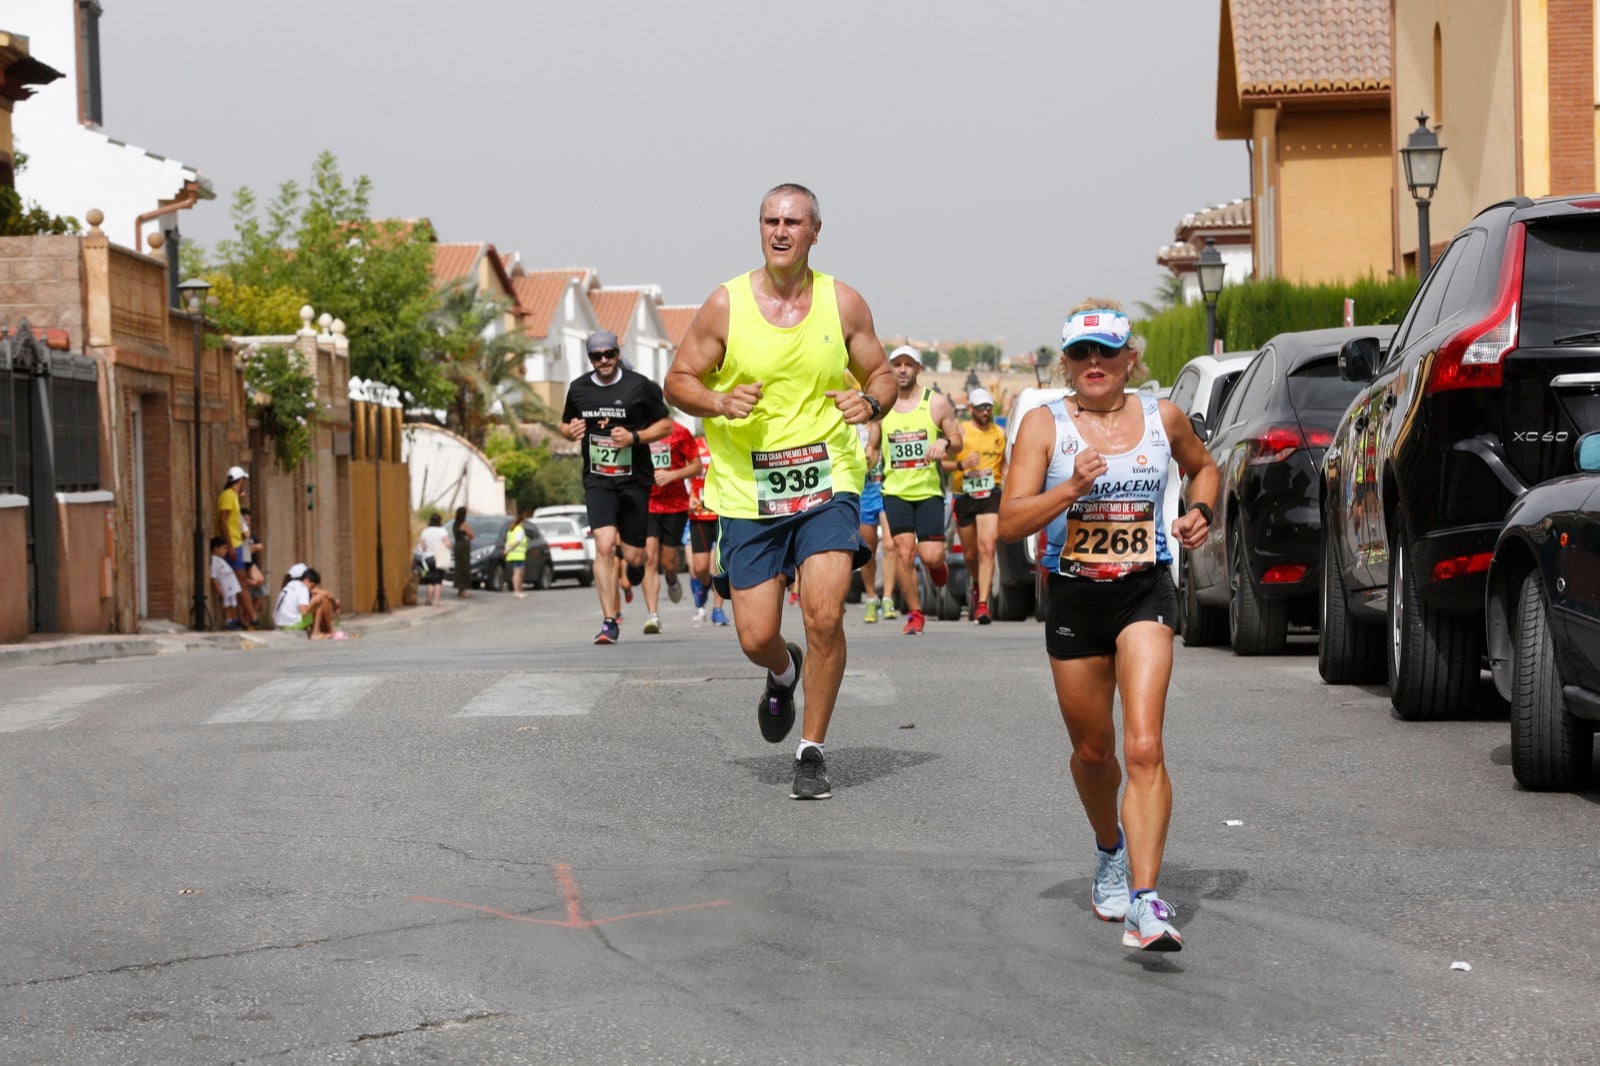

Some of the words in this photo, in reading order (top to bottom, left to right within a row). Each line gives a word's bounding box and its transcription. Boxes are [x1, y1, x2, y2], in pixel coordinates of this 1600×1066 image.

[783, 448, 802, 460] PREMIO
[802, 447, 809, 457] DE
[895, 443, 924, 458] 388
[768, 466, 820, 494] 938
[969, 478, 989, 489] 147
[1089, 479, 1161, 496] ARACENA
[1099, 502, 1122, 513] PREMIO
[1122, 502, 1131, 512] DE
[1073, 528, 1148, 555] 2268
